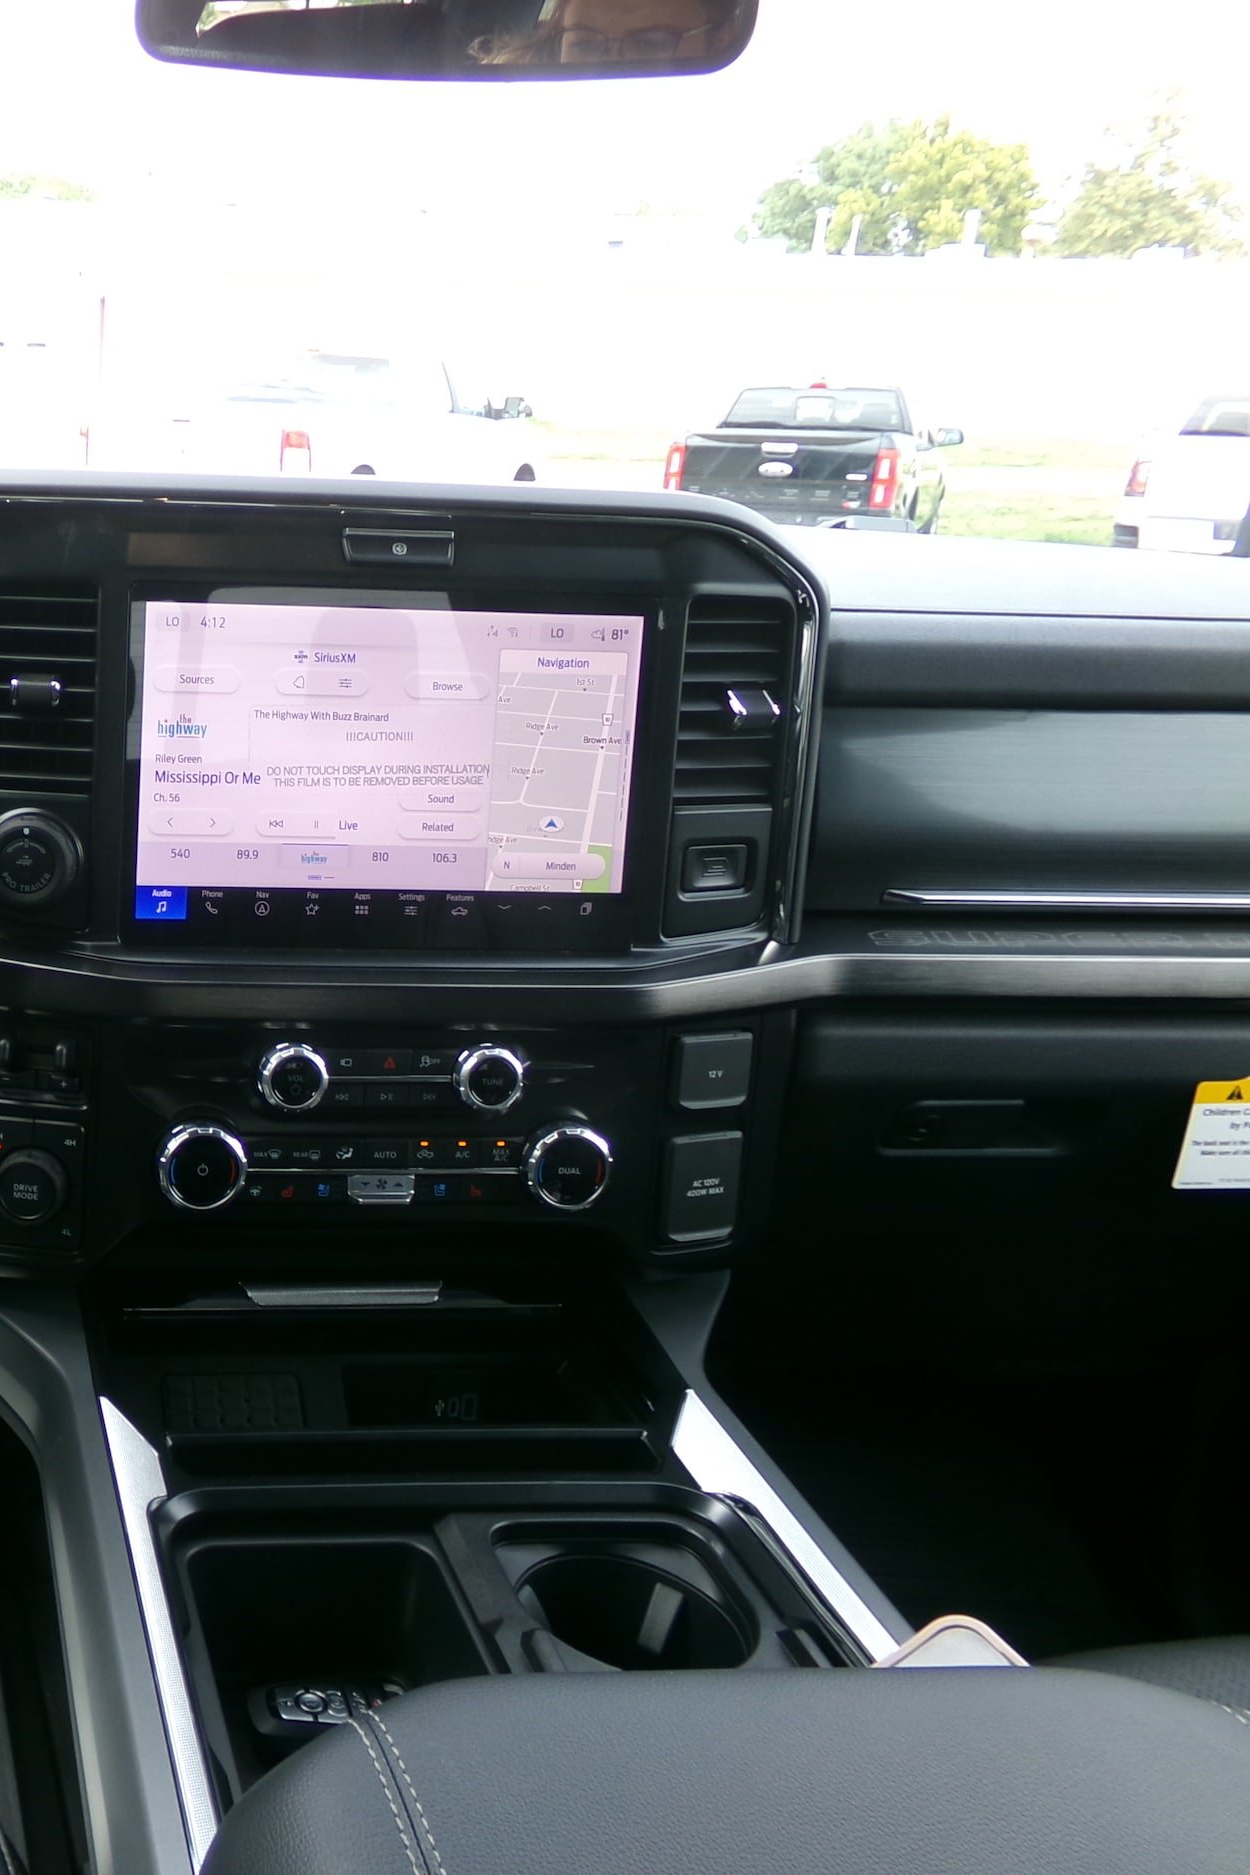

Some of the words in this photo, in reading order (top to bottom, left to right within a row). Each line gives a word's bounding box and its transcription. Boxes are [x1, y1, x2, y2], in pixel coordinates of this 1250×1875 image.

[165, 616, 180, 628] LO
[200, 616, 226, 629] 4:12
[550, 628, 565, 639] LO
[611, 628, 630, 641] 81°
[313, 652, 357, 664] SiriusXM
[537, 657, 590, 669] Navigation
[179, 674, 215, 685] Sources
[432, 682, 464, 692] Browse
[254, 709, 271, 720] The
[271, 710, 310, 722] Highway
[310, 710, 332, 721] With
[332, 711, 352, 722] Buzz
[354, 712, 389, 722] Brainard
[157, 719, 207, 738] highway
[583, 736, 607, 745] Brown
[608, 737, 623, 745] Ave
[155, 754, 176, 766] Riley
[177, 754, 203, 764] Green
[266, 766, 282, 777] DO
[283, 766, 304, 776] NOT
[307, 765, 340, 776] TOUCH
[342, 765, 383, 775] DISPLAY
[384, 764, 421, 775] DURING
[423, 763, 491, 775] INSTALLATION
[154, 770, 222, 786] Mississippi
[224, 771, 240, 785] Or
[242, 771, 261, 785] Me
[273, 777, 295, 788] THIS
[299, 777, 321, 787] FILM
[322, 777, 332, 787] IS
[333, 777, 347, 787] TO
[349, 777, 362, 787] BE
[363, 776, 411, 786] REMOVED
[412, 776, 451, 786] BEFORE
[451, 775, 484, 785] USAGE
[153, 792, 168, 803] Ch.
[168, 793, 181, 803] 56
[427, 794, 455, 804] Sound
[338, 819, 358, 831] Live
[421, 822, 454, 832] Related
[170, 848, 191, 859] 540
[236, 850, 259, 860] 89.9
[371, 852, 389, 862] 810
[432, 853, 458, 863] 106.3
[503, 861, 511, 870] N
[545, 861, 577, 871] Minden
[152, 889, 172, 898] Audio
[202, 890, 224, 899] Phone
[256, 890, 270, 899] Nav
[307, 891, 320, 900] Fav
[354, 892, 371, 901] Apps
[398, 893, 426, 902] Settings
[446, 893, 475, 902] Features
[63, 1138, 77, 1147] 4H
[373, 1151, 398, 1159] AUTO
[455, 1150, 470, 1159] A/C
[557, 1167, 582, 1176] DUAL
[13, 1183, 39, 1193] DRIVE
[708, 1186, 725, 1196] MAX
[13, 1191, 39, 1201] MODE
